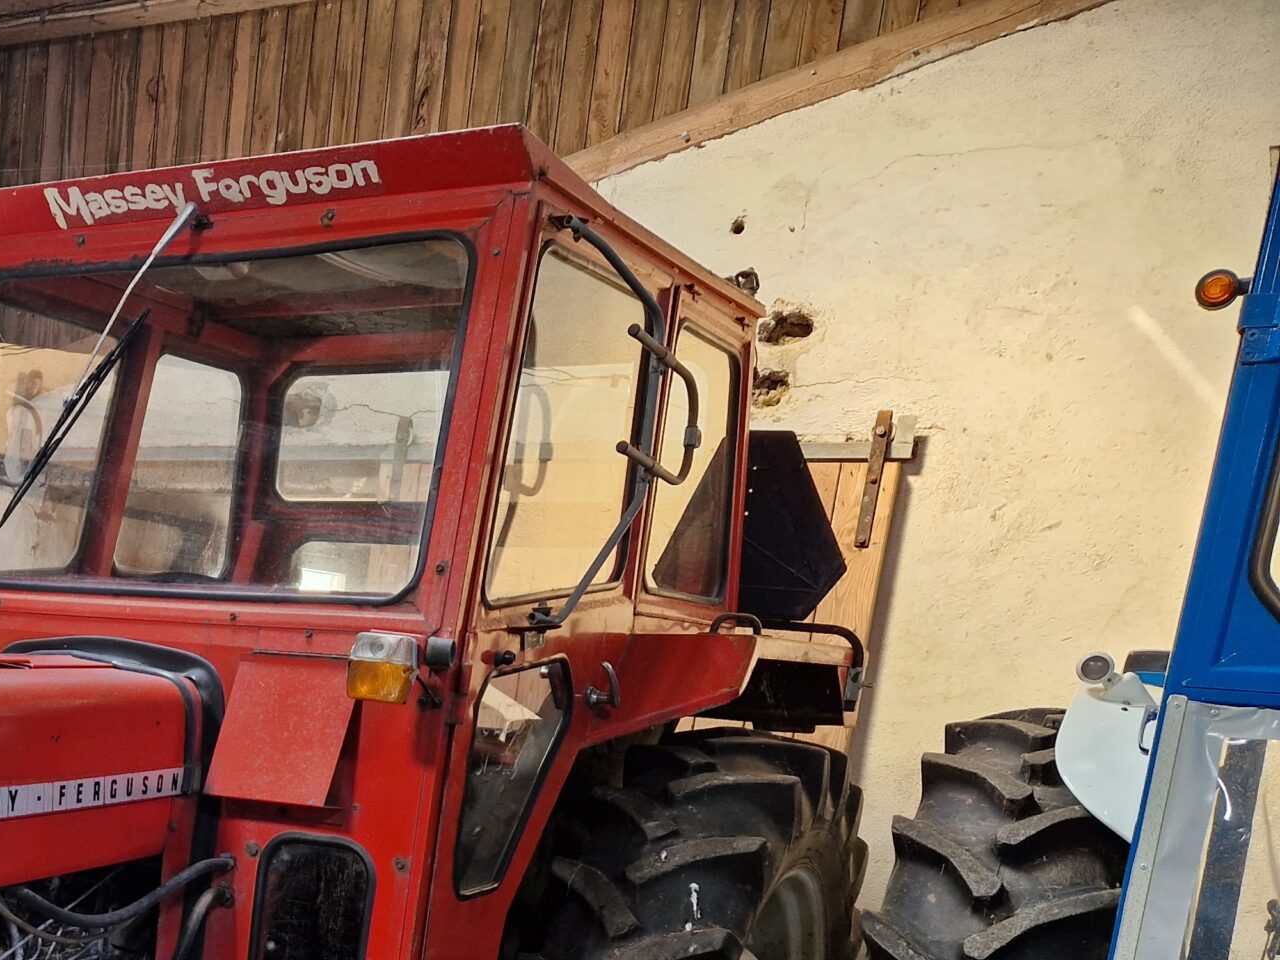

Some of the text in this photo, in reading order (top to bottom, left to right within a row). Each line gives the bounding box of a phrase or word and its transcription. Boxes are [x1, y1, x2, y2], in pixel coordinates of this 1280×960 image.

[43, 160, 381, 230] Massey Ferguson
[58, 772, 179, 806] FERGUSON
